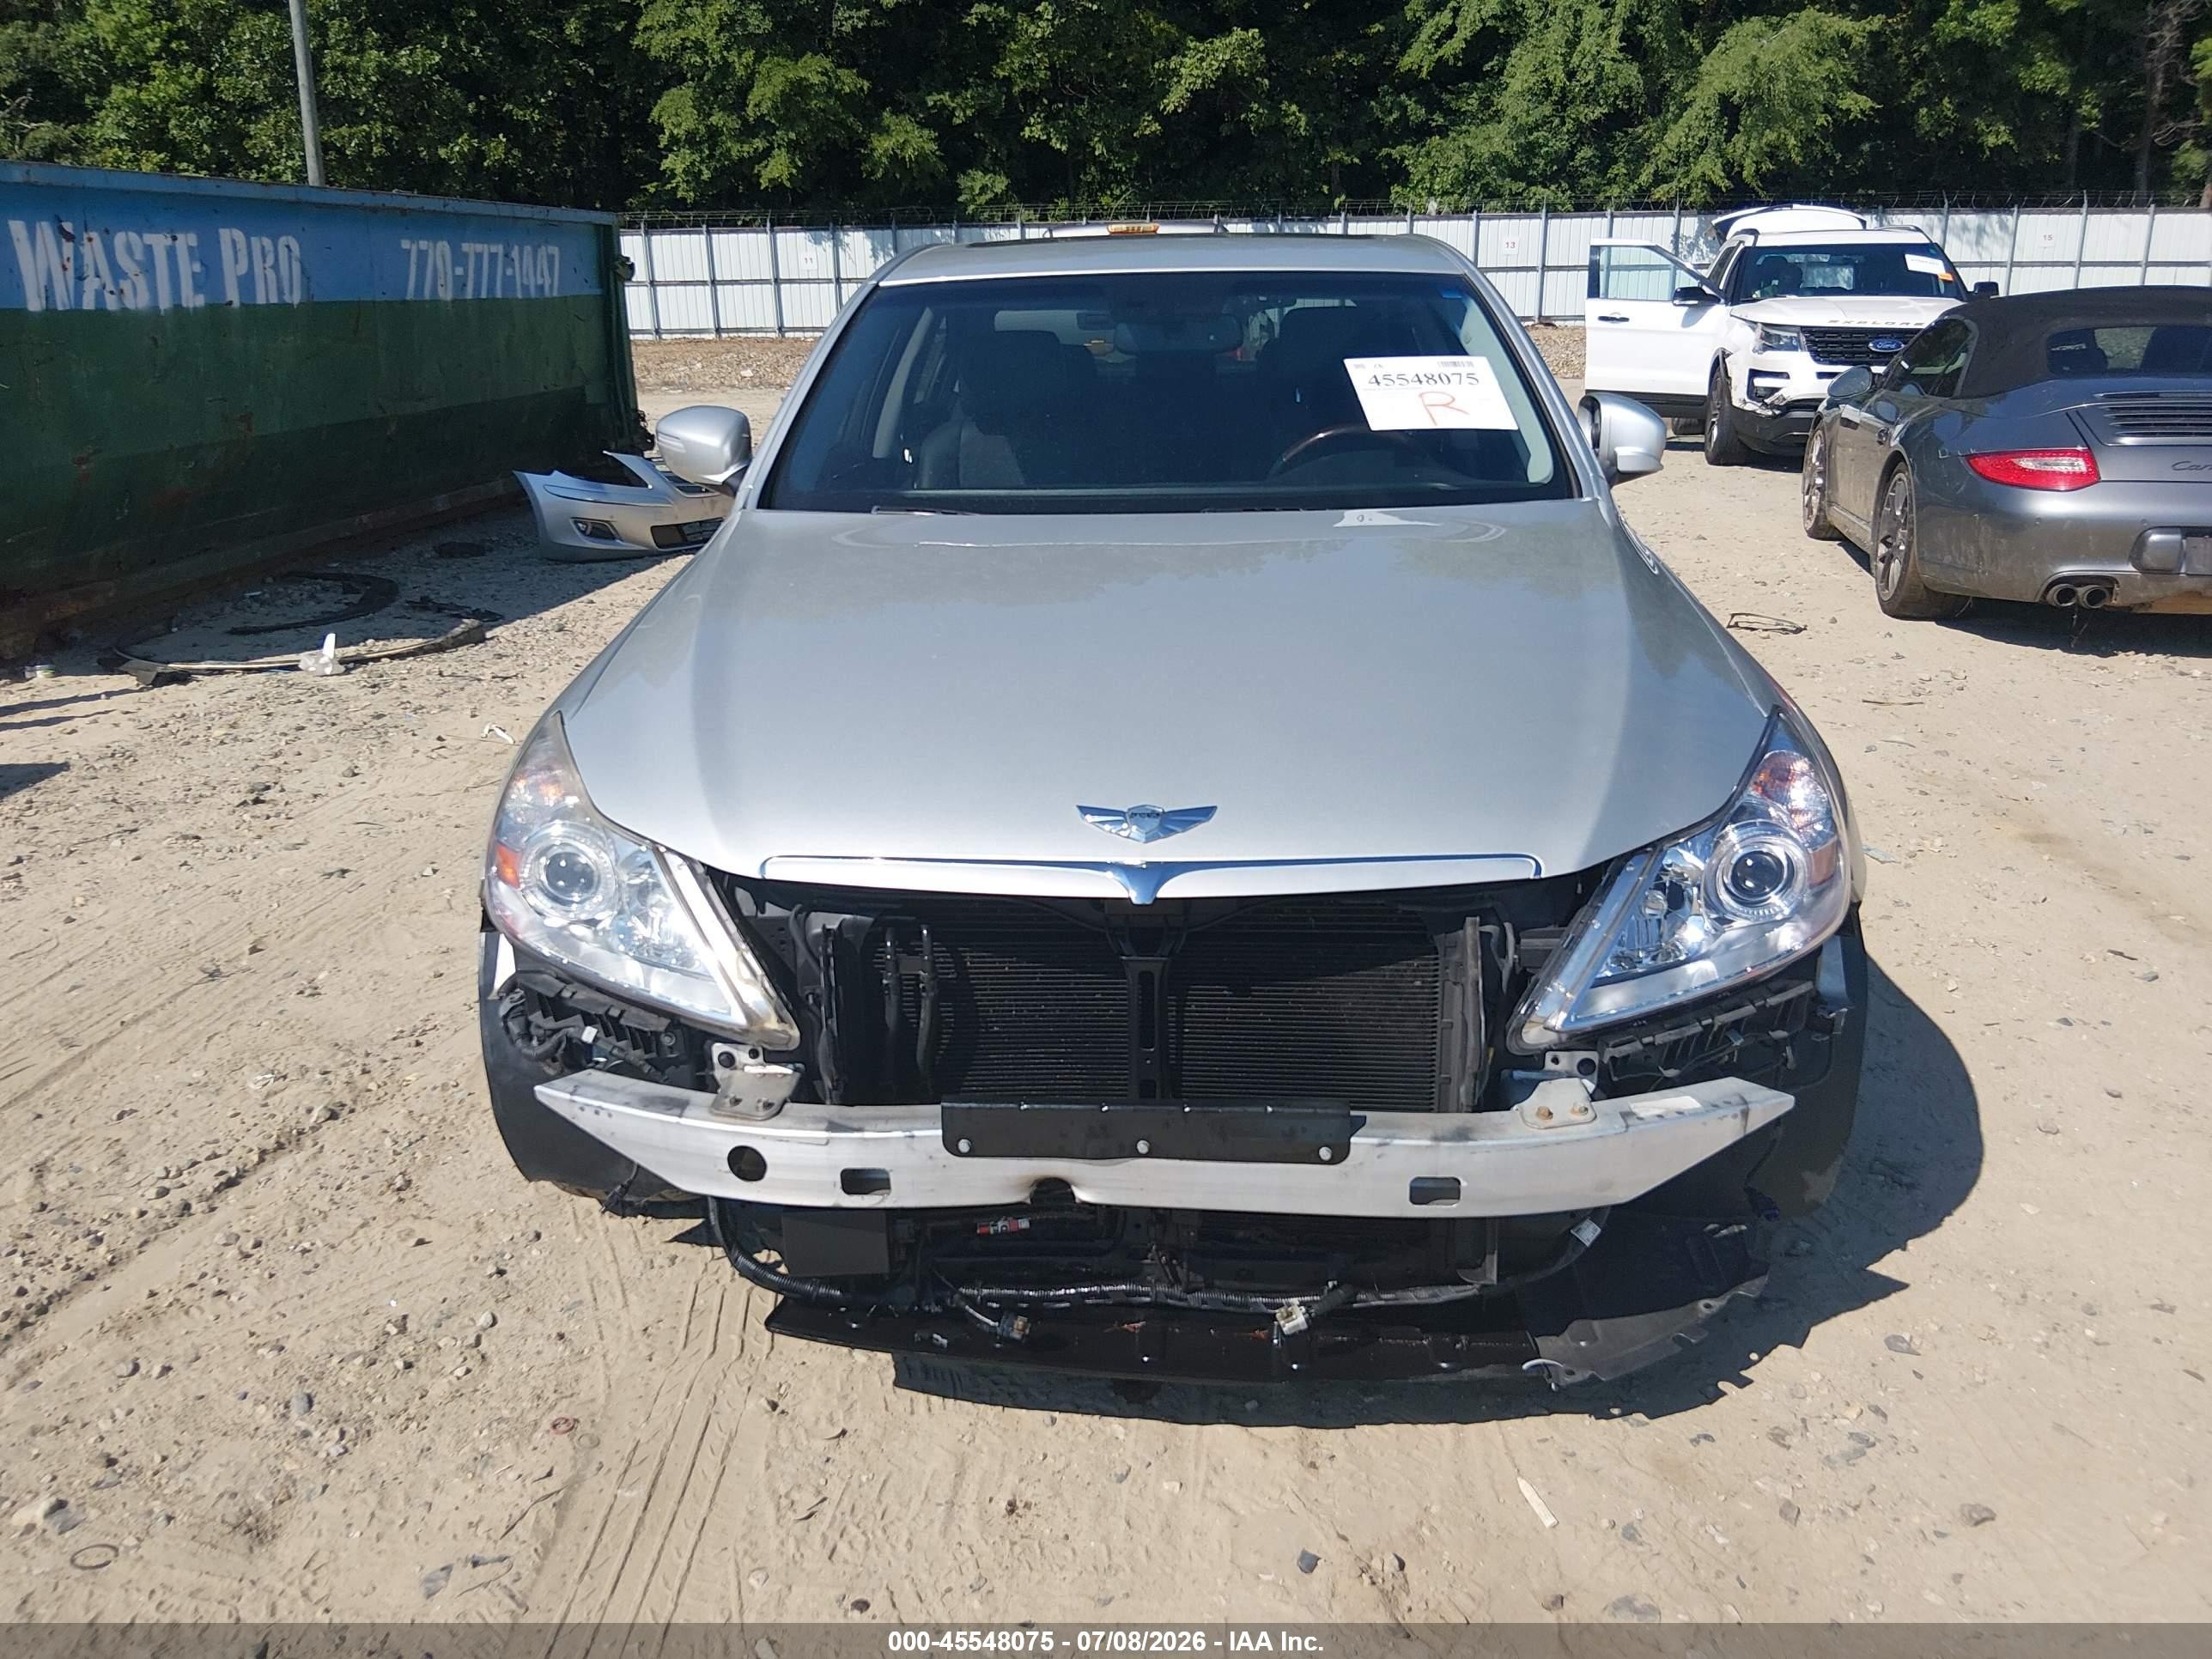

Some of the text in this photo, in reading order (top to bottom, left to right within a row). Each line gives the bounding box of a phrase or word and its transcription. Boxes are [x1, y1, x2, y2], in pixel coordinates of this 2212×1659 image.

[400, 239, 559, 301] 770-777-1447
[1368, 372, 1479, 386] 45548075
[1419, 391, 1470, 426] R
